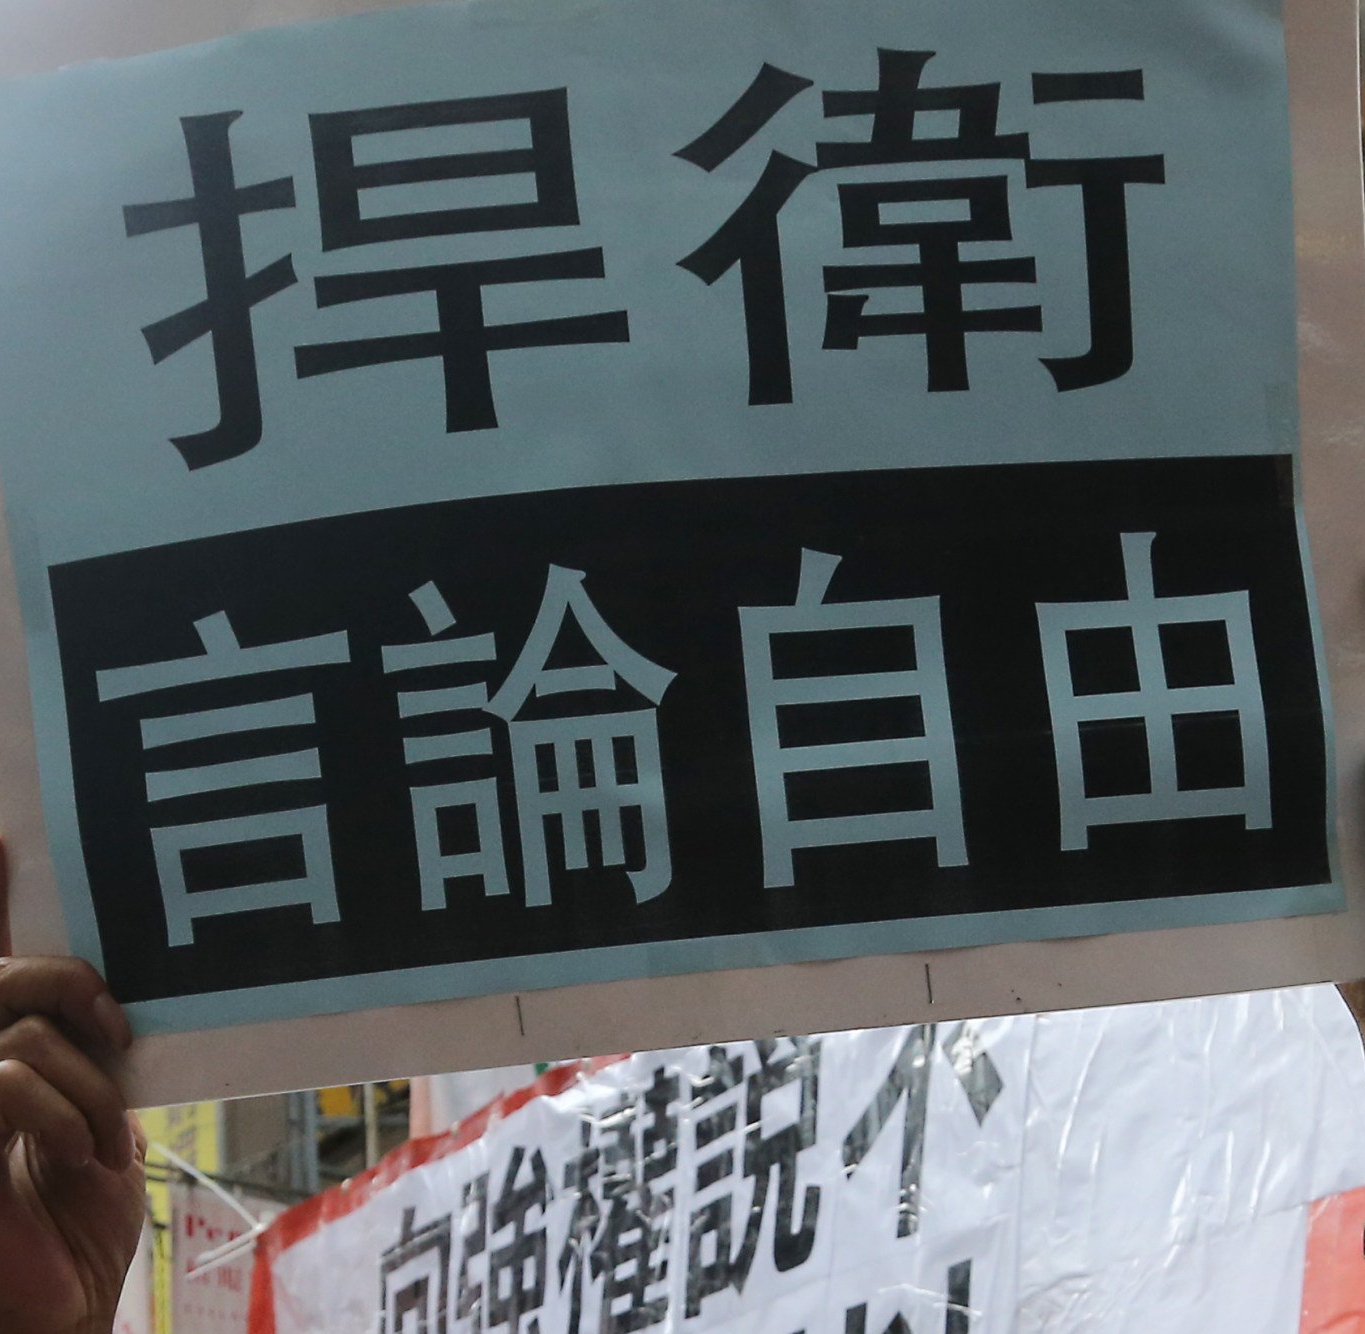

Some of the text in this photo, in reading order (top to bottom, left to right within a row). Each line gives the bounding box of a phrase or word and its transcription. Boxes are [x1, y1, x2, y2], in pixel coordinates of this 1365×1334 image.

[122, 47, 1166, 471] 捍衛
[95, 532, 1273, 949] 言論自由
